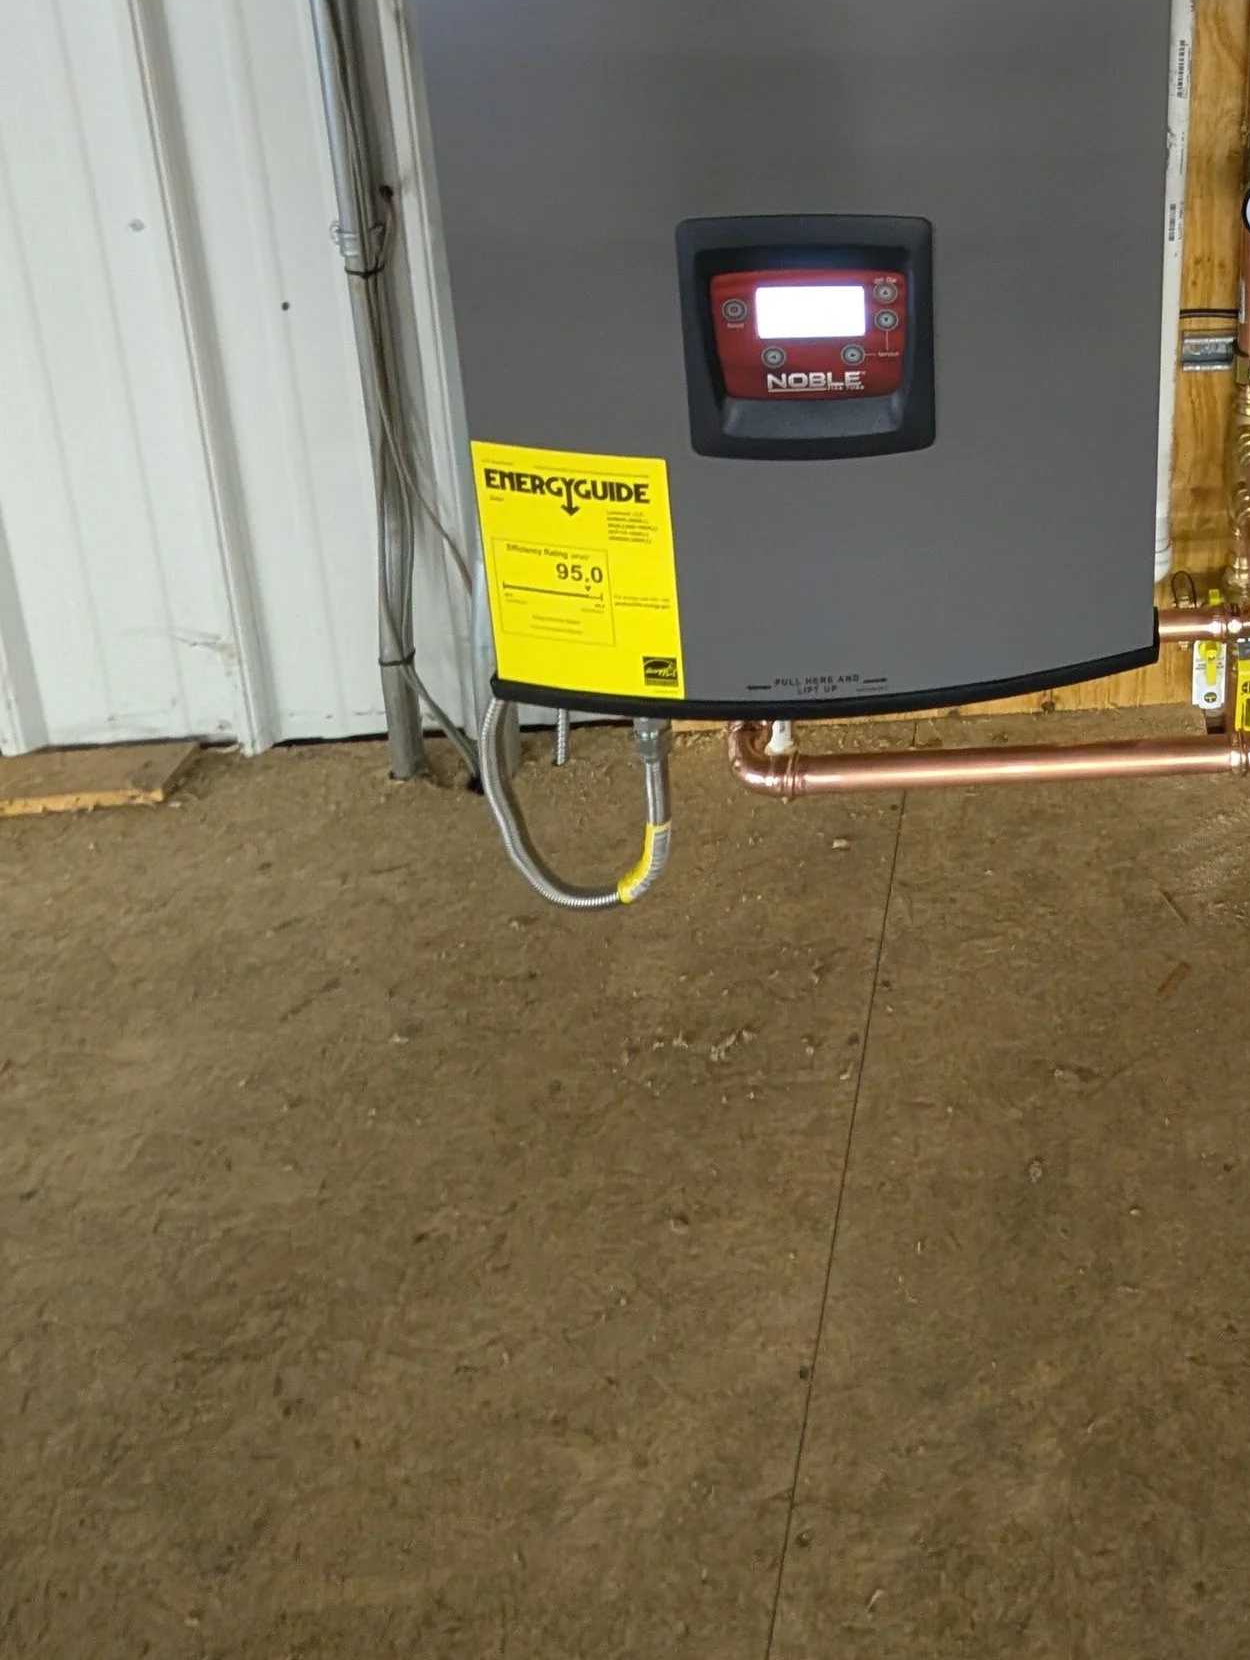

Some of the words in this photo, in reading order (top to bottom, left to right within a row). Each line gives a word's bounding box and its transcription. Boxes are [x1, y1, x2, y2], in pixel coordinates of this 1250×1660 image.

[766, 371, 863, 390] NOBLE
[484, 467, 651, 508] ENERGYGUIDE
[506, 543, 543, 556] Efficiency
[543, 547, 569, 560] Rating
[555, 562, 604, 584] 95.0
[774, 677, 801, 687] PULL
[804, 676, 834, 685] HERE
[837, 674, 860, 683] AND
